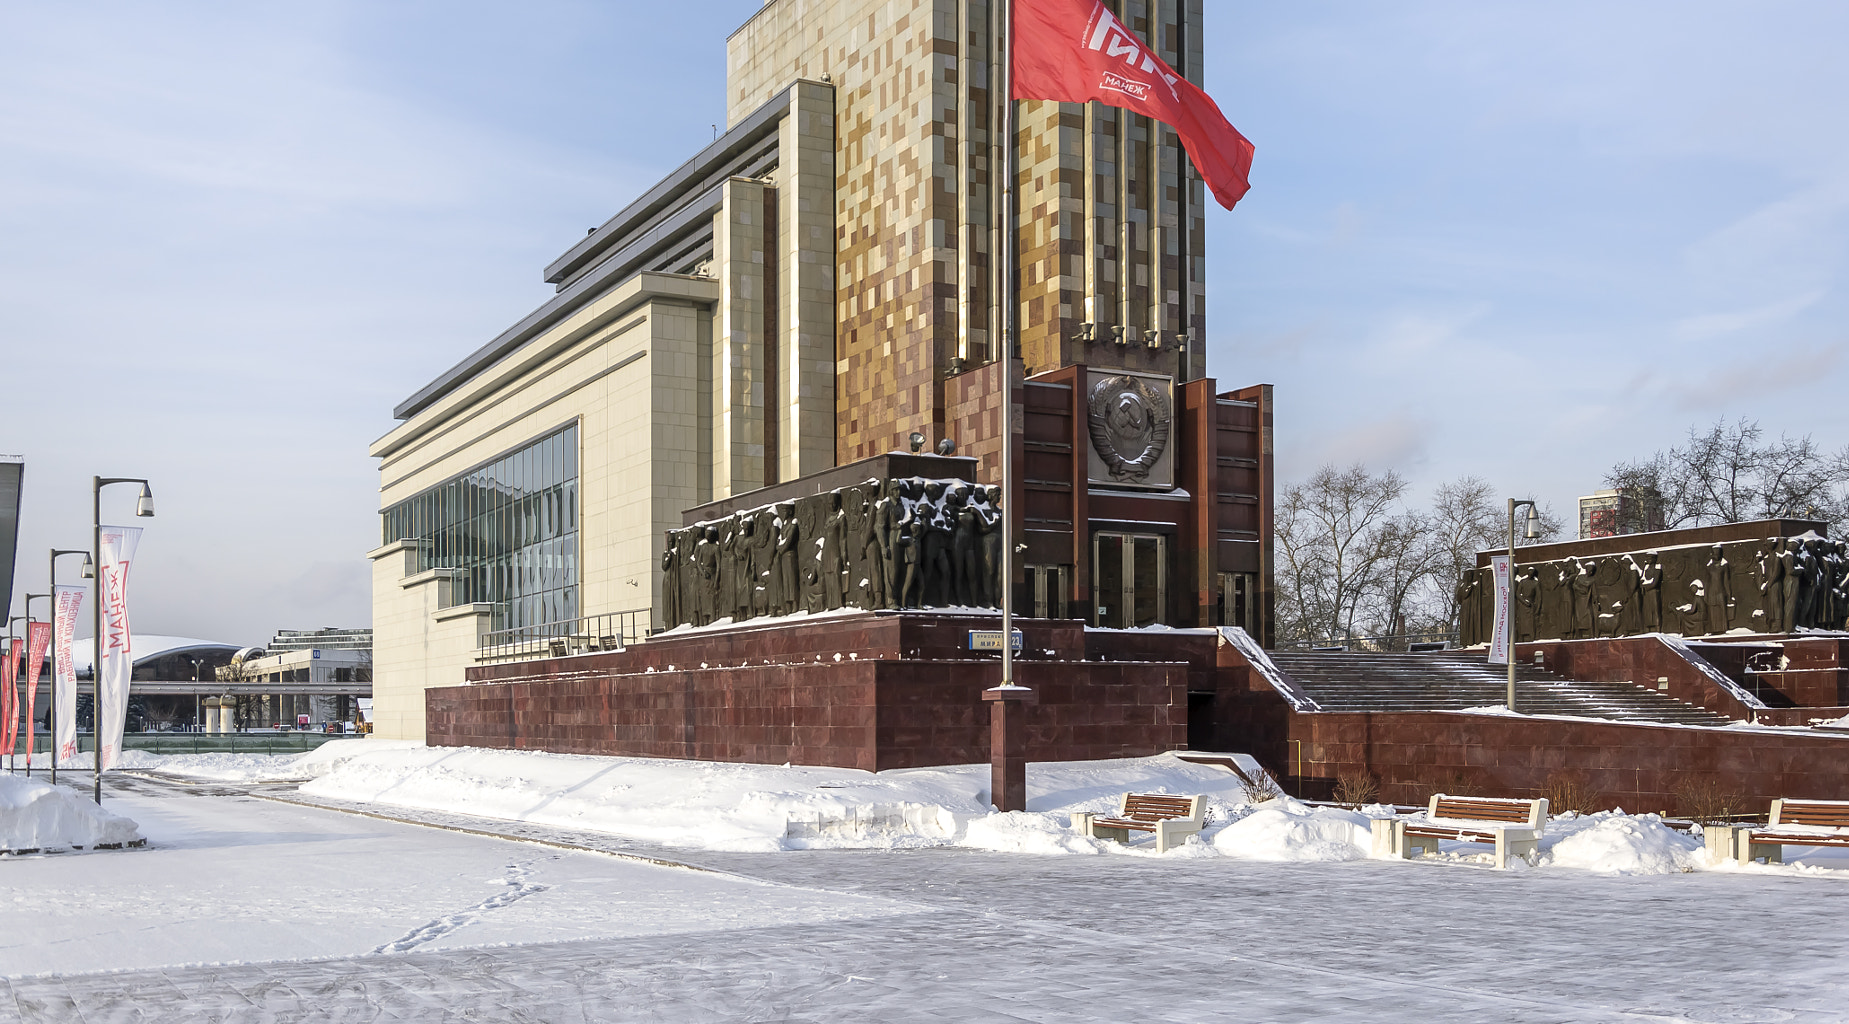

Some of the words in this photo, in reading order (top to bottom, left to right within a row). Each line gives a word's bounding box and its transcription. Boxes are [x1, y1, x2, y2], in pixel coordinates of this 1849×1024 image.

[1104, 75, 1146, 95] МАНЕЖ
[58, 591, 71, 614] ЦЕНТР
[64, 591, 84, 637] КОЛХОЗНИЦА
[109, 570, 123, 648] МАНЕЖ
[62, 647, 75, 683] РАБОЧИЙ
